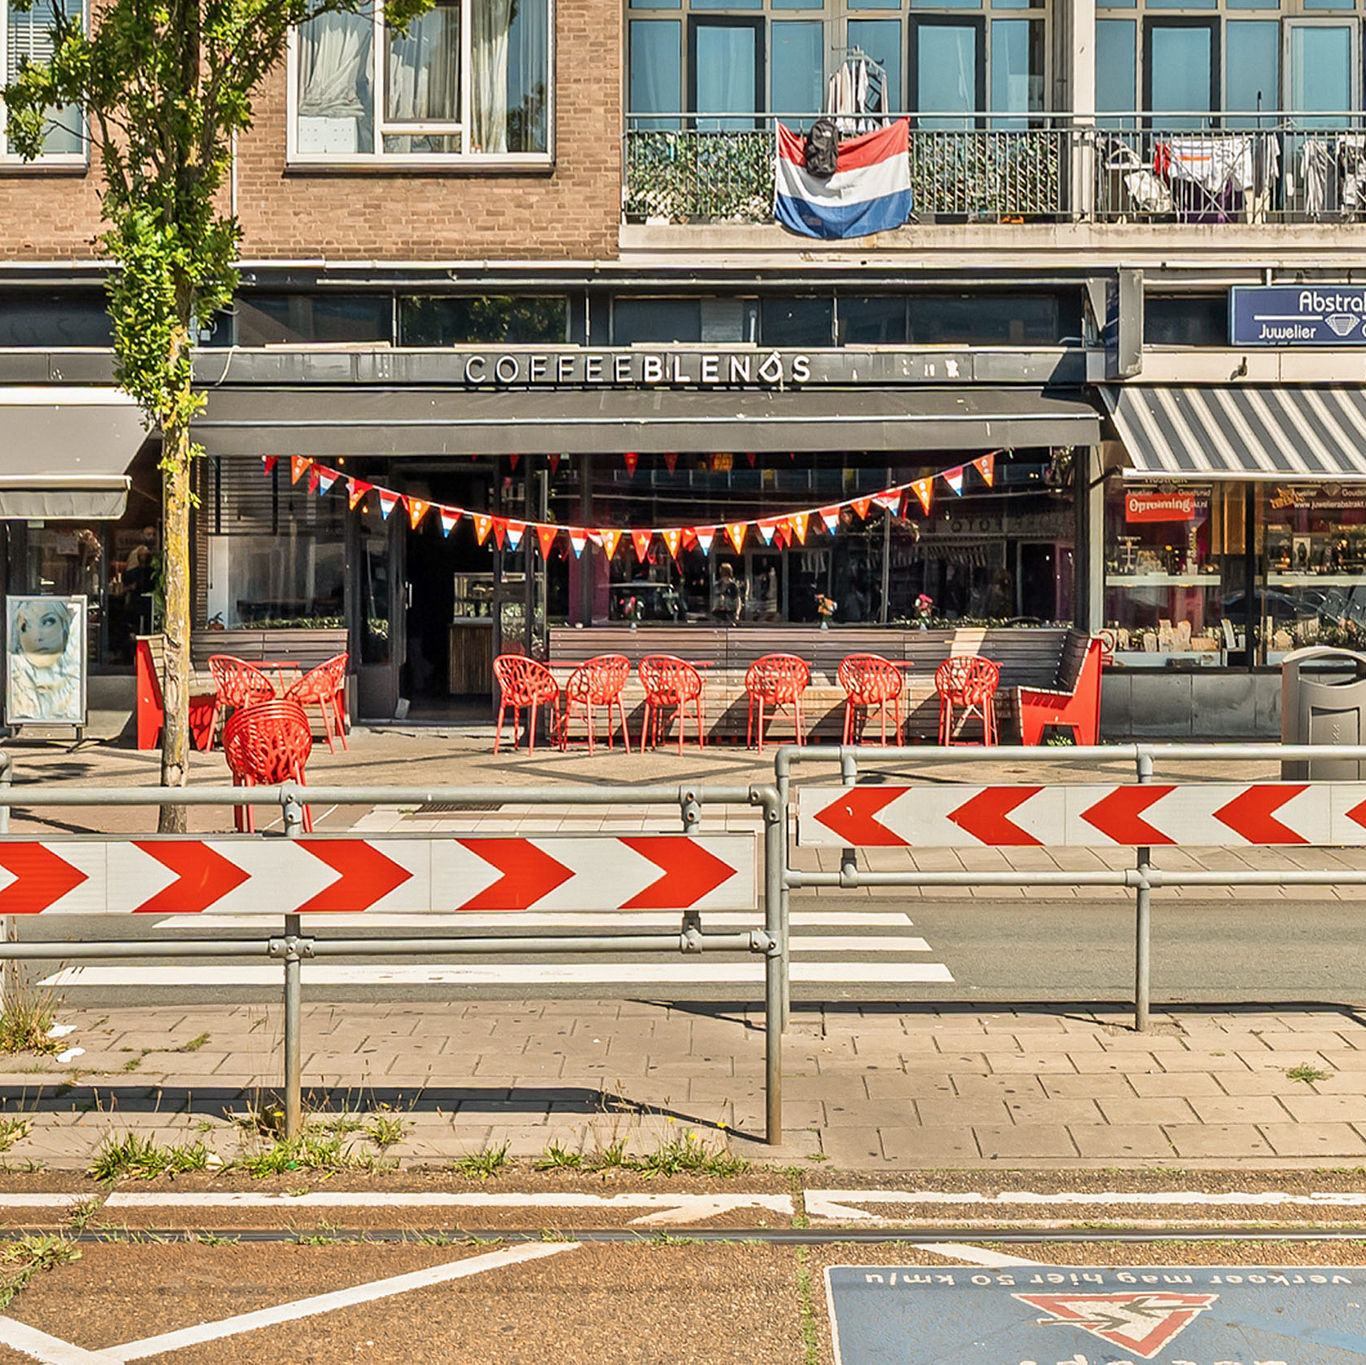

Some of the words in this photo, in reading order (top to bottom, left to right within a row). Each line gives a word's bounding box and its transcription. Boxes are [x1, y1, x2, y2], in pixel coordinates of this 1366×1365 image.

[1258, 323, 1317, 339] Juwelier
[865, 1272, 955, 1286] km/u
[971, 1274, 1016, 1286] 50
[1030, 1272, 1104, 1286] hier
[1116, 1272, 1193, 1284] mag
[1209, 1274, 1352, 1285] verkeer
